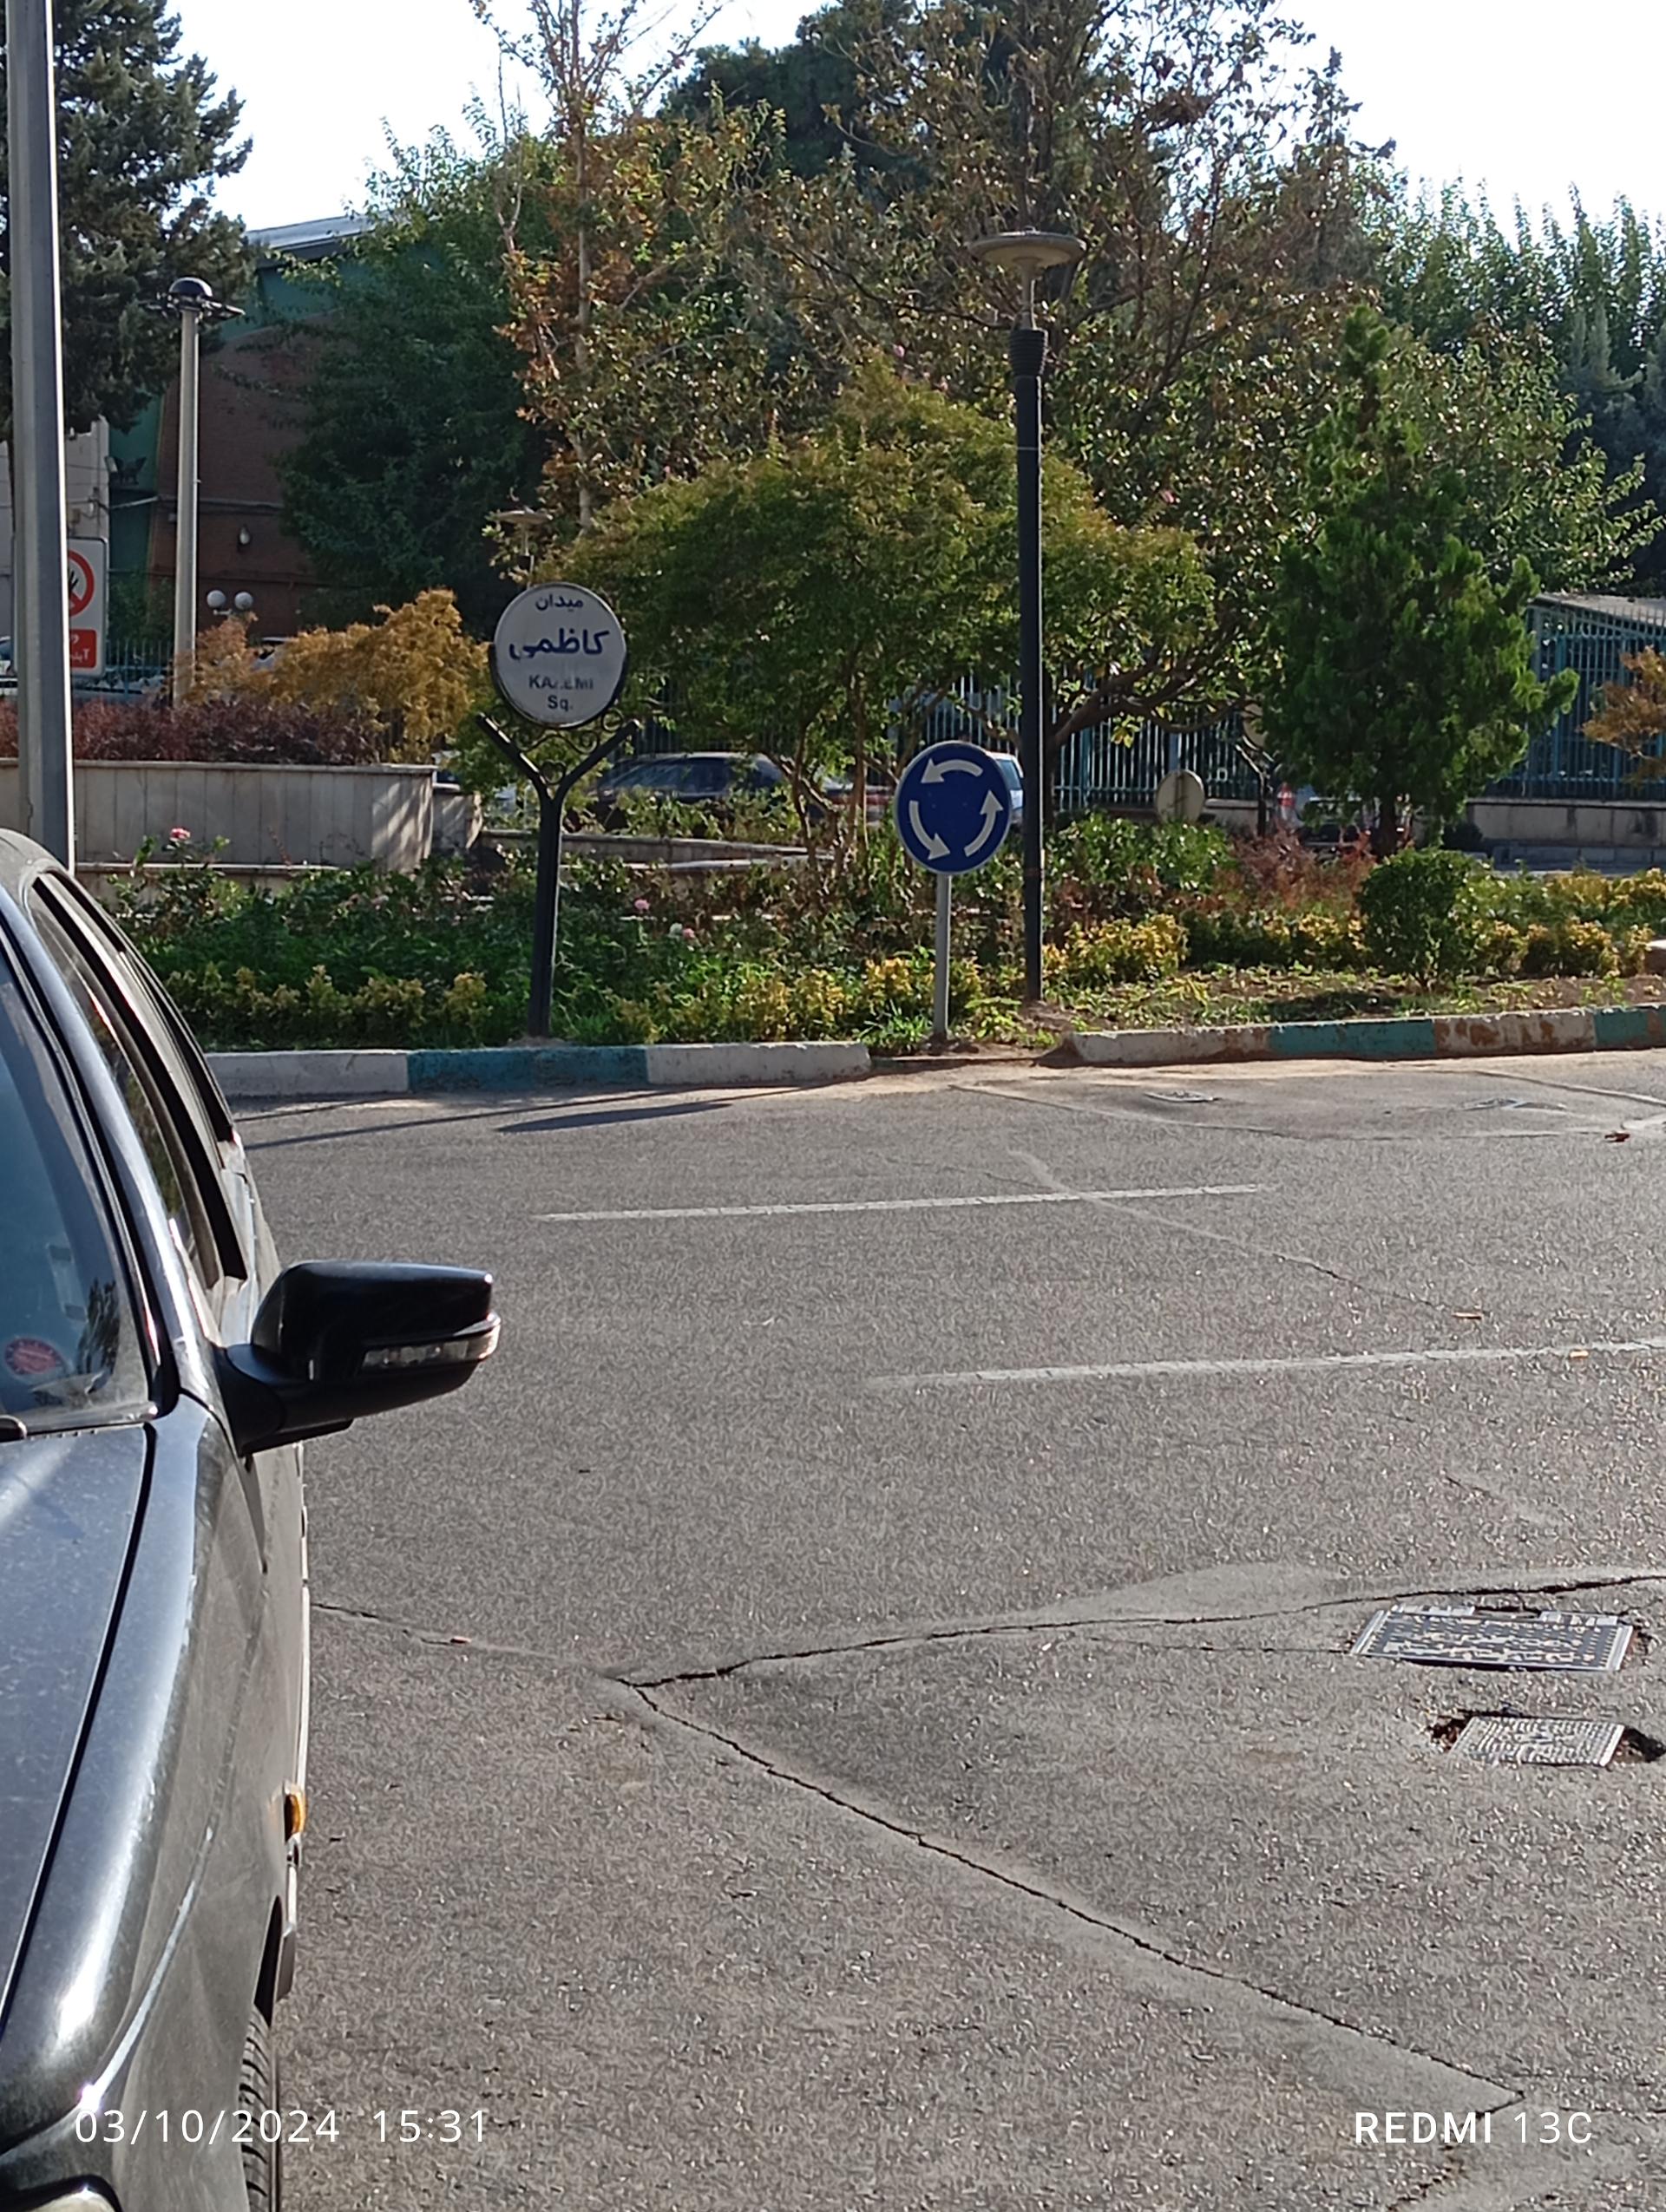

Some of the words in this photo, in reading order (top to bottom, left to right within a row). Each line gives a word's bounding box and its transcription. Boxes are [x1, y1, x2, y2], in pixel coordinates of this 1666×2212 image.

[535, 593, 584, 612] میدان
[508, 627, 610, 660] کاظمی
[528, 674, 594, 690] KAEMI
